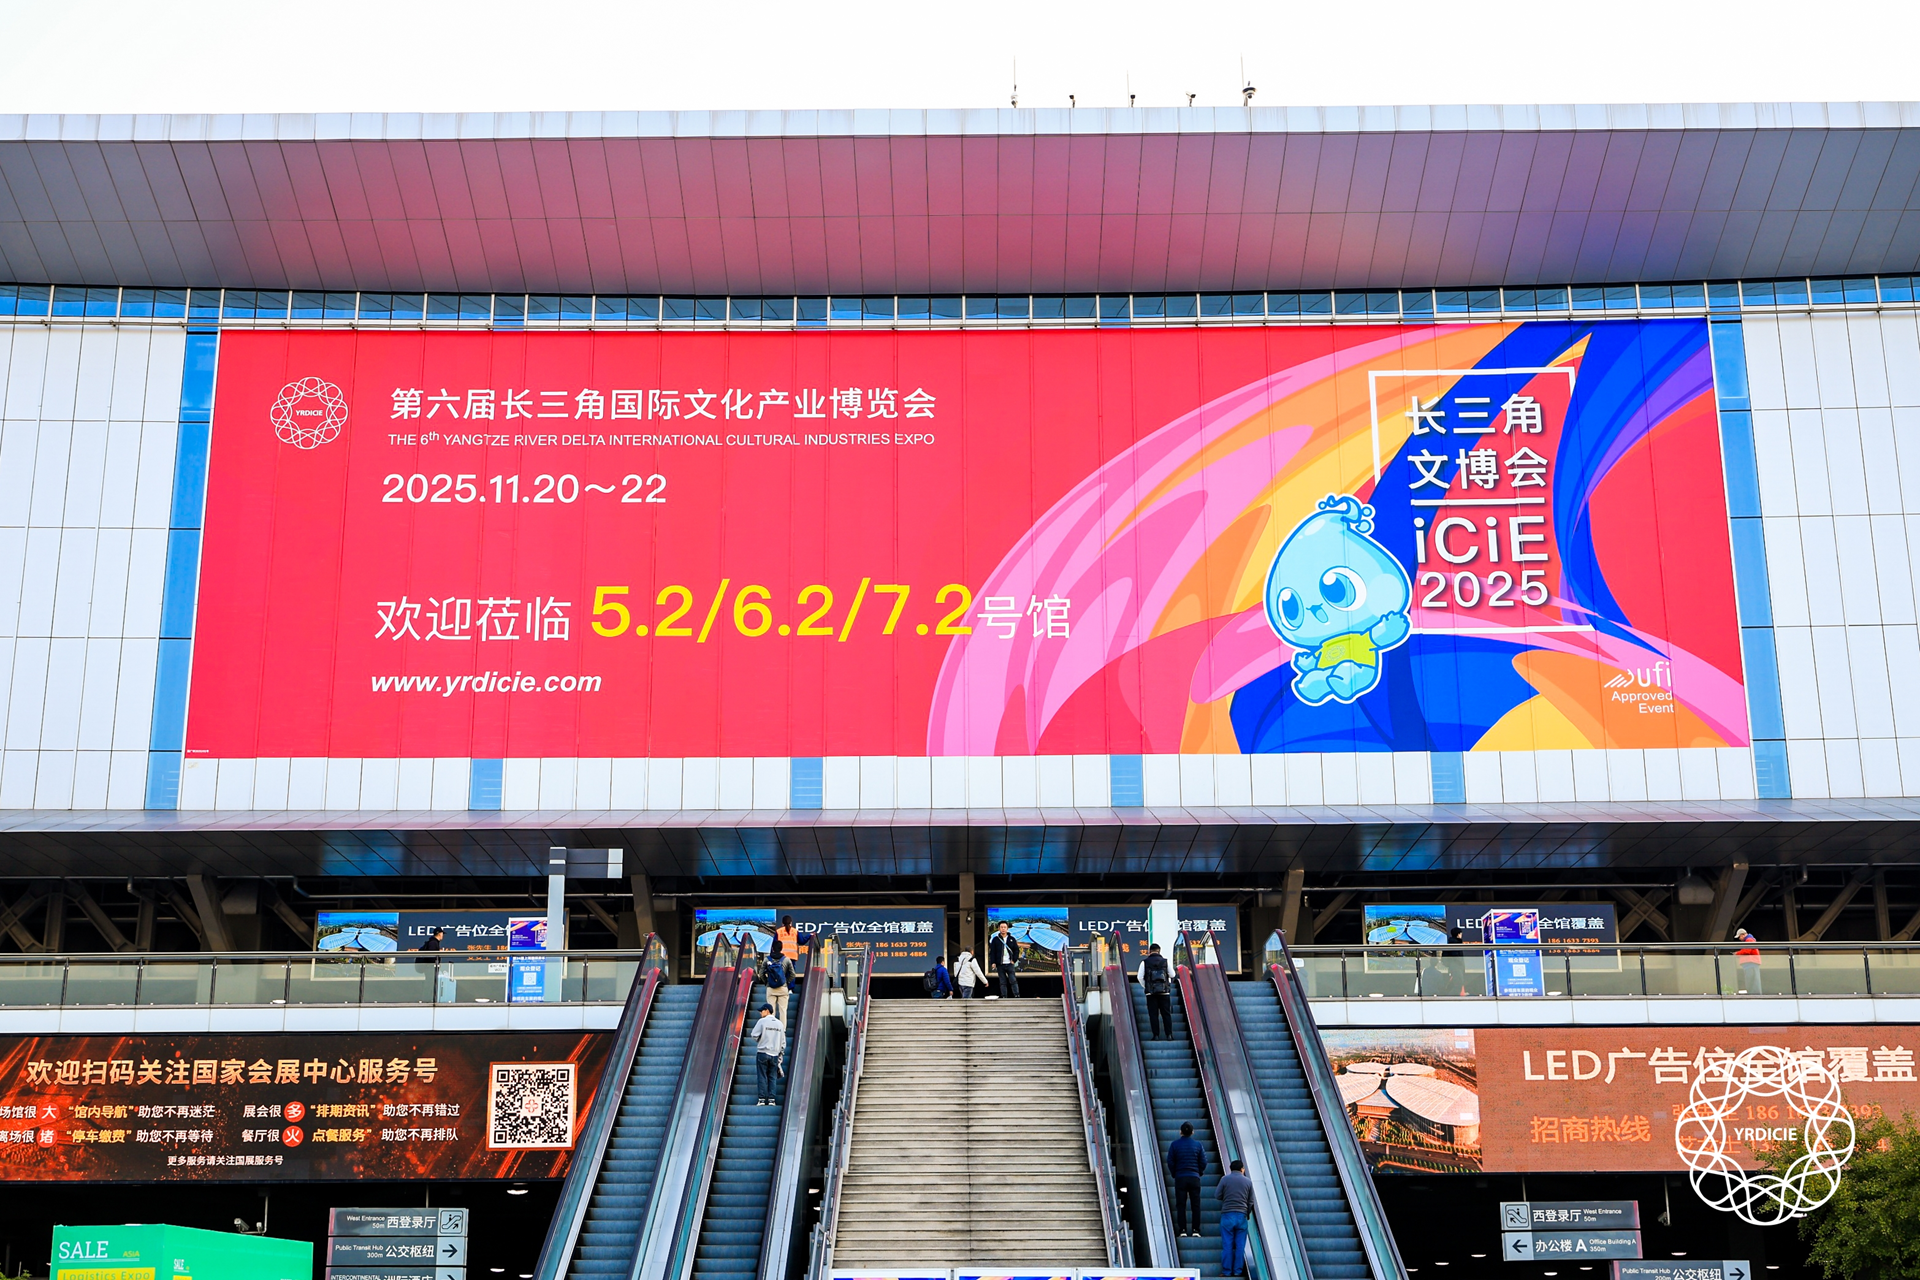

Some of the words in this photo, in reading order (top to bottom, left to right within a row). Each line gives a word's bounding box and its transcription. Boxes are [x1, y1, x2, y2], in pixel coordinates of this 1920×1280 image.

[390, 387, 936, 420] 第六届长三角国际文化产业博览会
[295, 409, 323, 417] YRDICIE
[1405, 393, 1544, 435] 长三角
[388, 434, 417, 446] THE
[443, 433, 510, 446] YANGTZE
[514, 434, 558, 446] RIVER
[561, 434, 606, 446] DELTA
[609, 434, 723, 446] INTERNATIONAL
[726, 434, 800, 446] CULTURAL
[804, 433, 890, 446] INDUSTRIES
[894, 432, 935, 445] EXPO
[1408, 447, 1549, 490] 文博会
[1415, 515, 1550, 564] iCiE
[1419, 570, 1549, 609] 2025
[374, 595, 572, 642] 欢迎莅临
[1637, 660, 1672, 688] ufi
[371, 671, 603, 698] www.yrdicie.com
[1611, 690, 1674, 704] Approved
[1638, 702, 1675, 714] Event
[26, 1058, 439, 1085] 欢迎扫码关注国家会展中心服务号
[1523, 1045, 1918, 1084] LED广告位全馆覆盖
[41, 1105, 57, 1119] 大
[137, 1105, 215, 1119] 助您不再迷茫
[242, 1104, 282, 1118] 展会很
[286, 1104, 302, 1119] 多
[383, 1103, 460, 1118] 助您不再错过
[1745, 1105, 1779, 1120] 186
[39, 1129, 55, 1144] 堵
[135, 1129, 214, 1143] 助您不再等待
[241, 1129, 280, 1143] 餐厅很
[285, 1129, 300, 1143] 火
[381, 1127, 459, 1142] 助您不再排队
[1530, 1115, 1652, 1143] 招商热线
[167, 1155, 284, 1166] 更多服务请关注国展服务号
[387, 1216, 436, 1229] 西登录厅
[1533, 1209, 1582, 1223] 西登录厅
[58, 1240, 109, 1259] SALE
[385, 1245, 435, 1258] 公交枢纽
[1535, 1239, 1573, 1253] 办公楼
[1575, 1239, 1588, 1252] A
[1672, 1268, 1722, 1280] 公交枢纽
